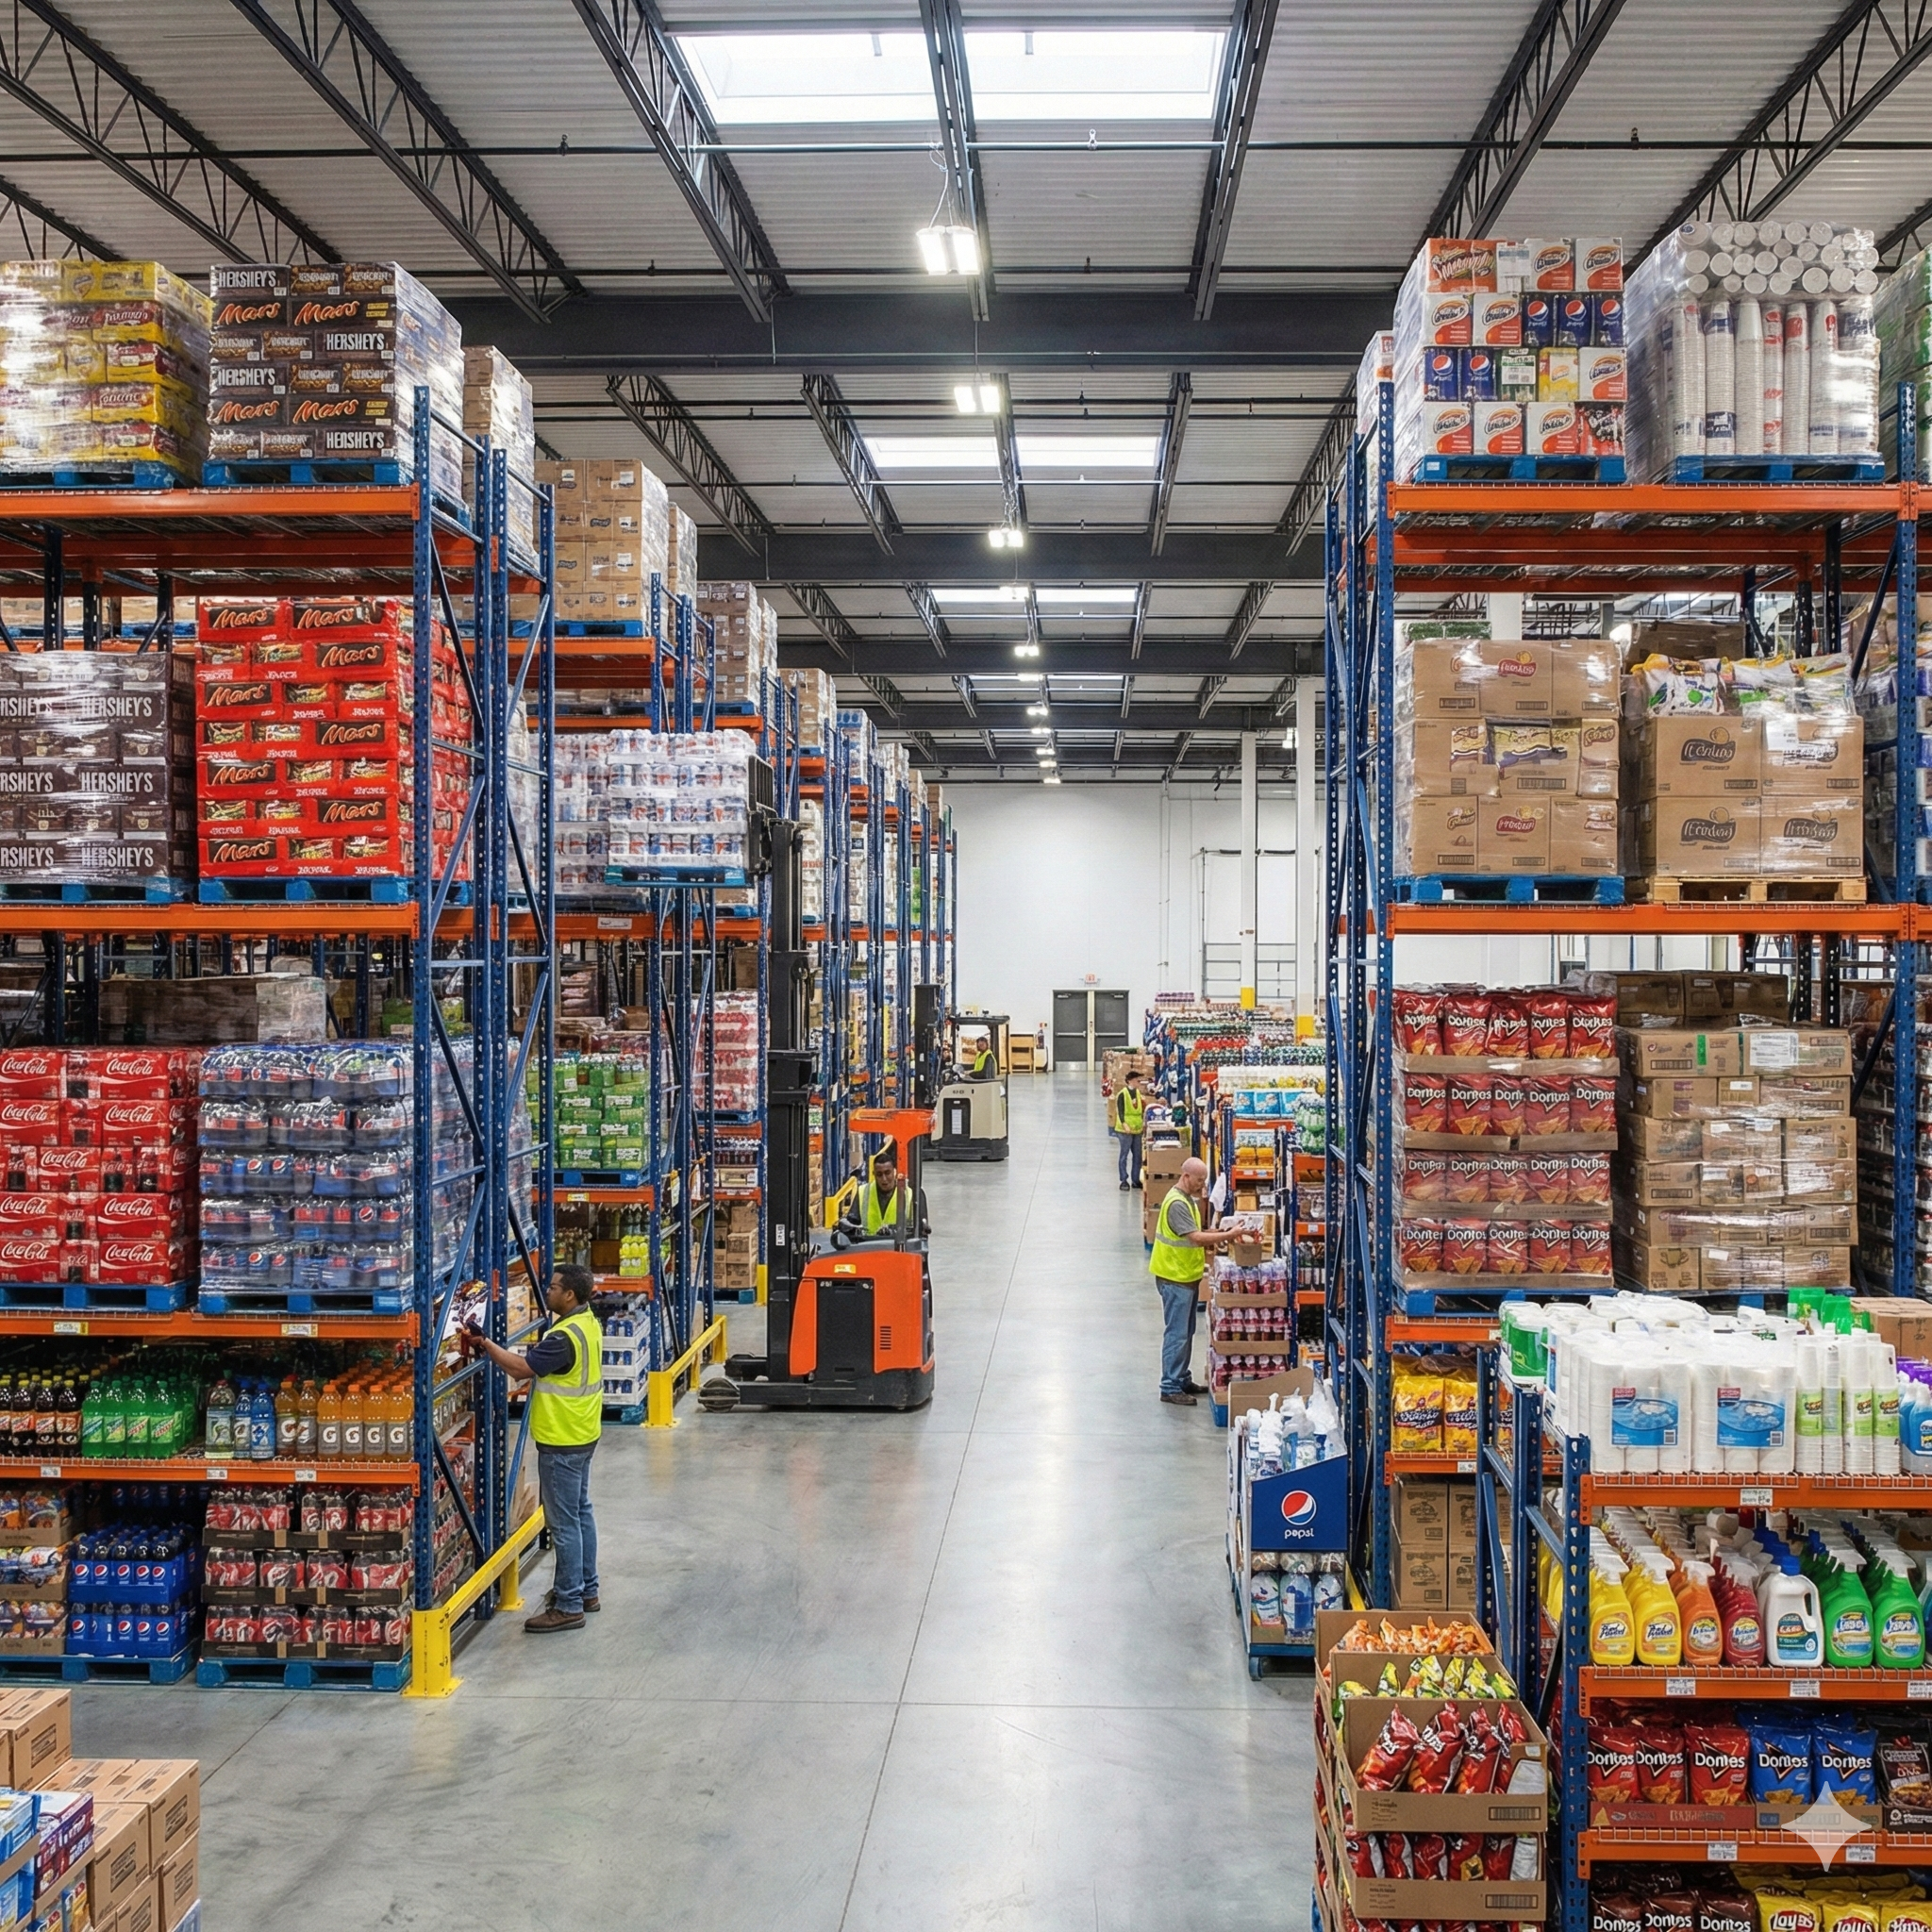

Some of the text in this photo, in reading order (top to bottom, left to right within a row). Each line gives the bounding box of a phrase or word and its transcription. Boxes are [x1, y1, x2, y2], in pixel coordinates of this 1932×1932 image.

[216, 302, 281, 325] Mars
[294, 300, 360, 326] Mars
[215, 400, 280, 424] Mars
[292, 399, 359, 425] Mars
[212, 608, 268, 629] Mars
[297, 608, 354, 629] Mars
[321, 645, 381, 668] Mars
[205, 684, 267, 708] Mars
[321, 724, 381, 745] Mars
[212, 763, 271, 786] Mars
[323, 801, 381, 824] Mars
[213, 841, 272, 864] Mars
[323, 1426, 337, 1443] G
[345, 1425, 359, 1443] G
[367, 1426, 380, 1443] G
[390, 1426, 404, 1443] G
[1284, 1527, 1315, 1540] pepsi
